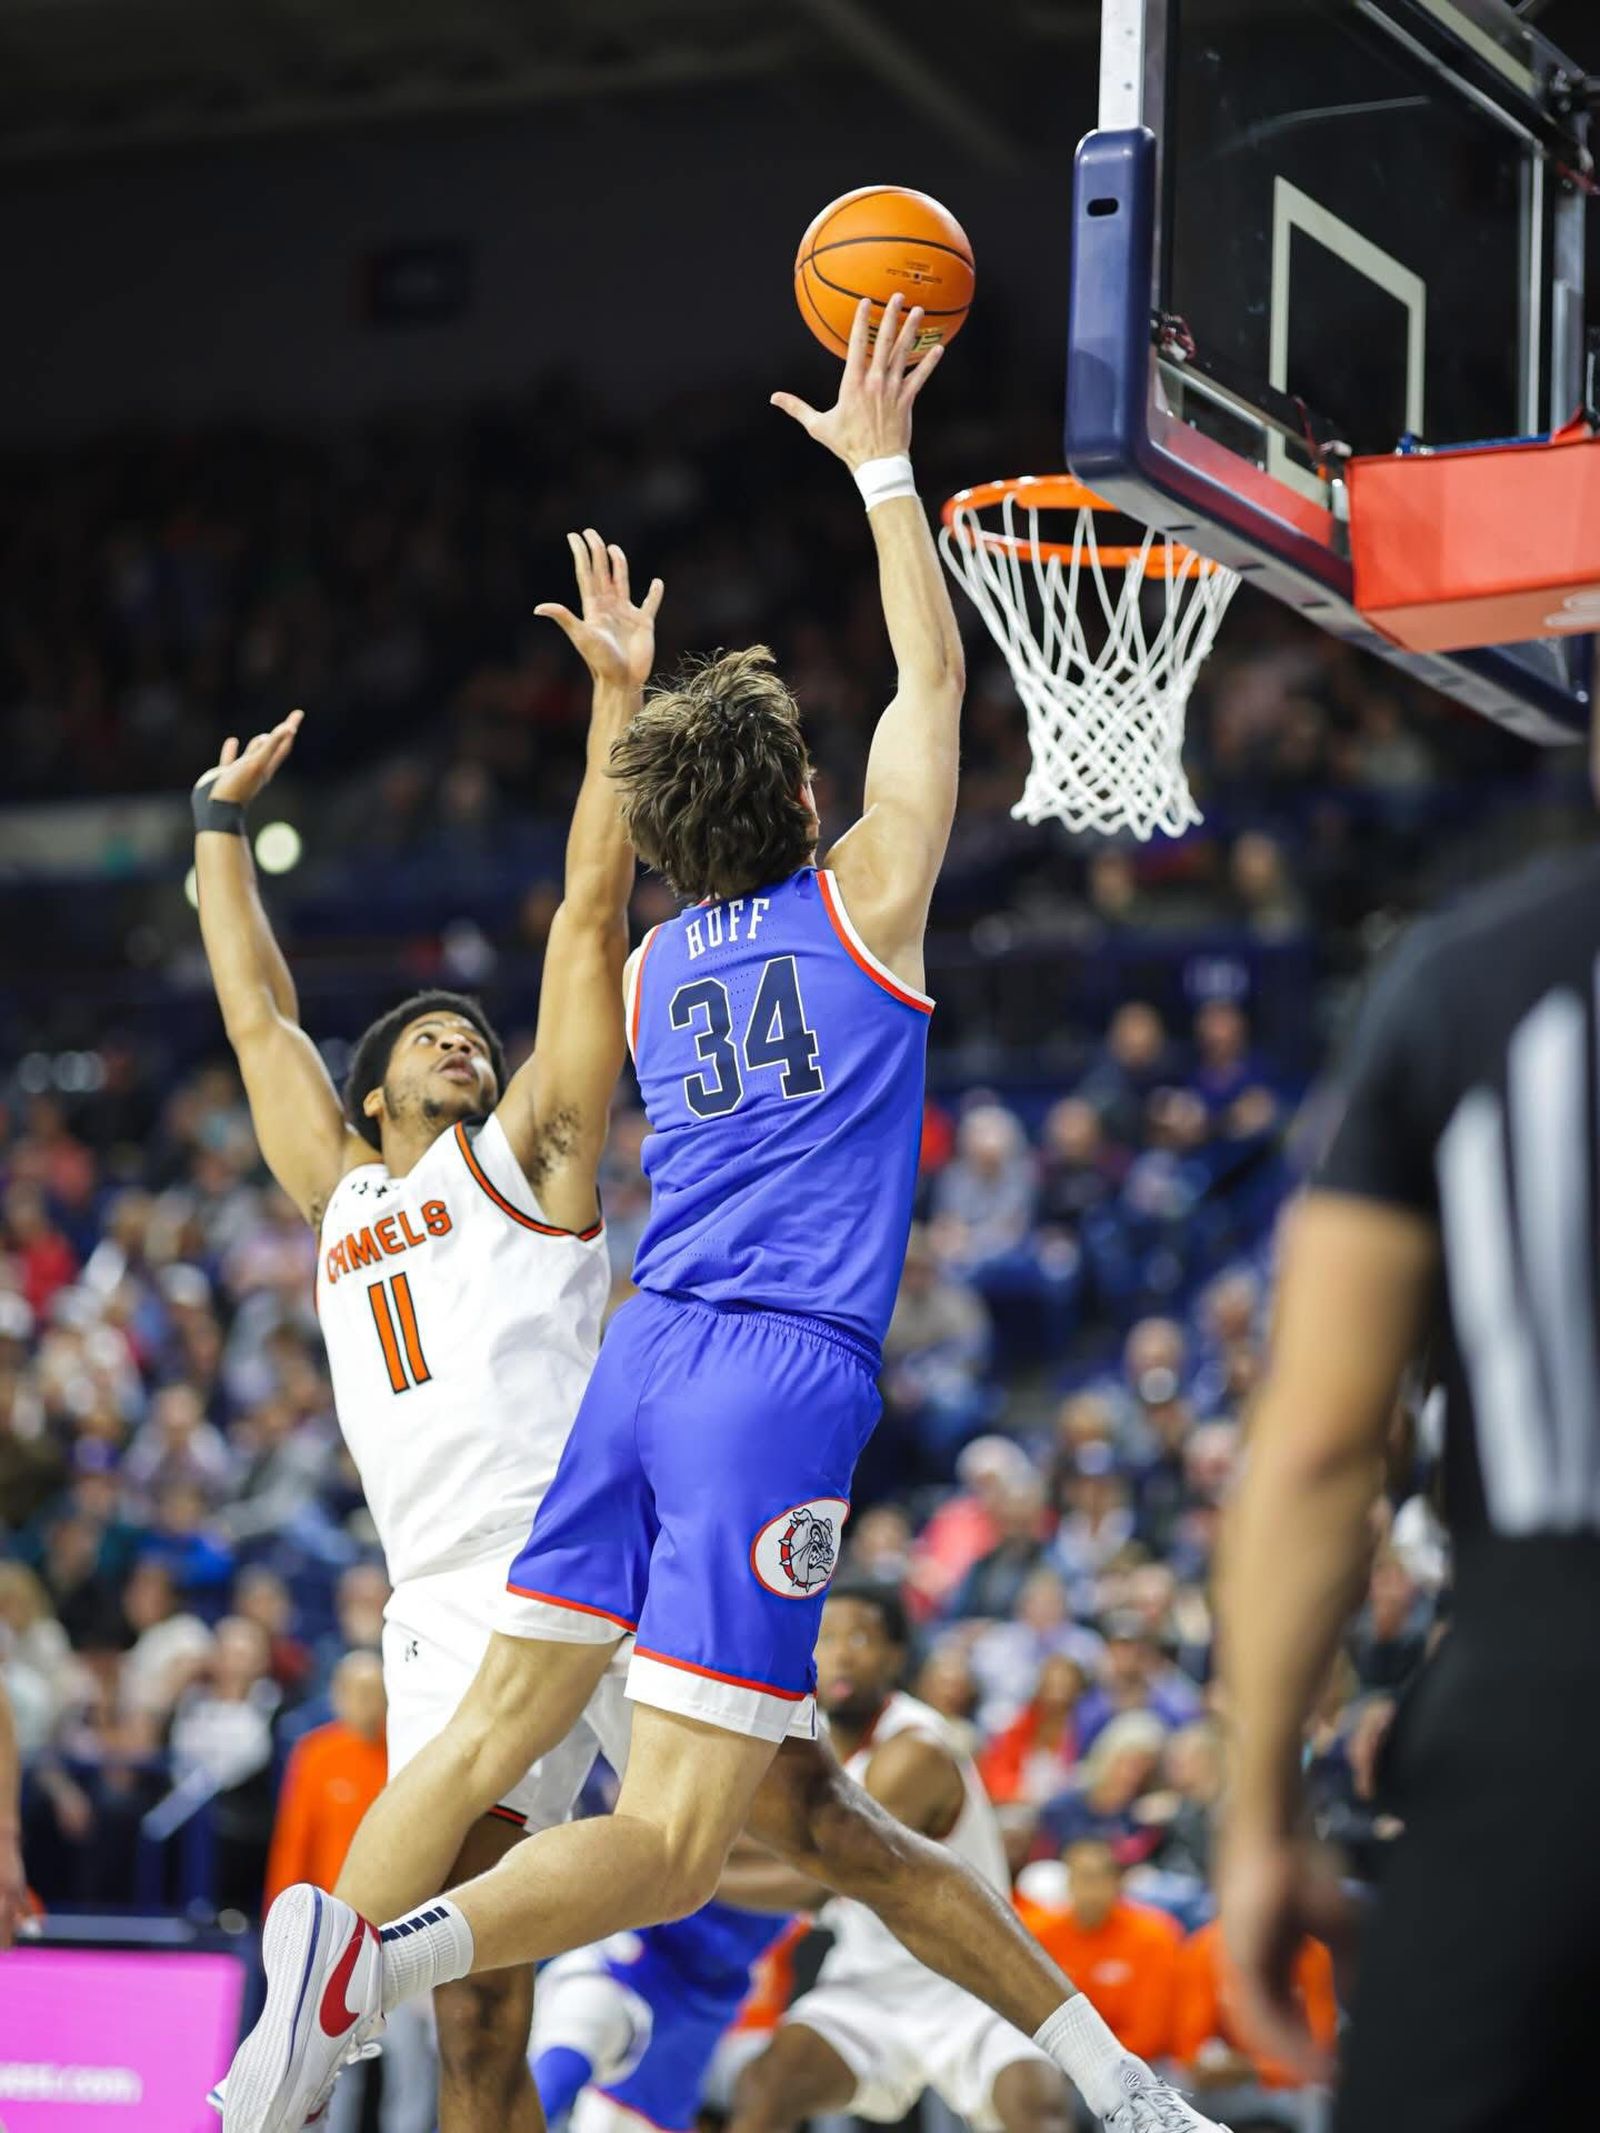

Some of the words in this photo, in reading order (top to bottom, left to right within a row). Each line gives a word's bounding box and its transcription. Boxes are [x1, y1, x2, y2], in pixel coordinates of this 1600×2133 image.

[685, 897, 771, 961] HUFF
[668, 954, 826, 1120] 34
[325, 1198, 454, 1285] CAMELS
[367, 1270, 432, 1395] 11
